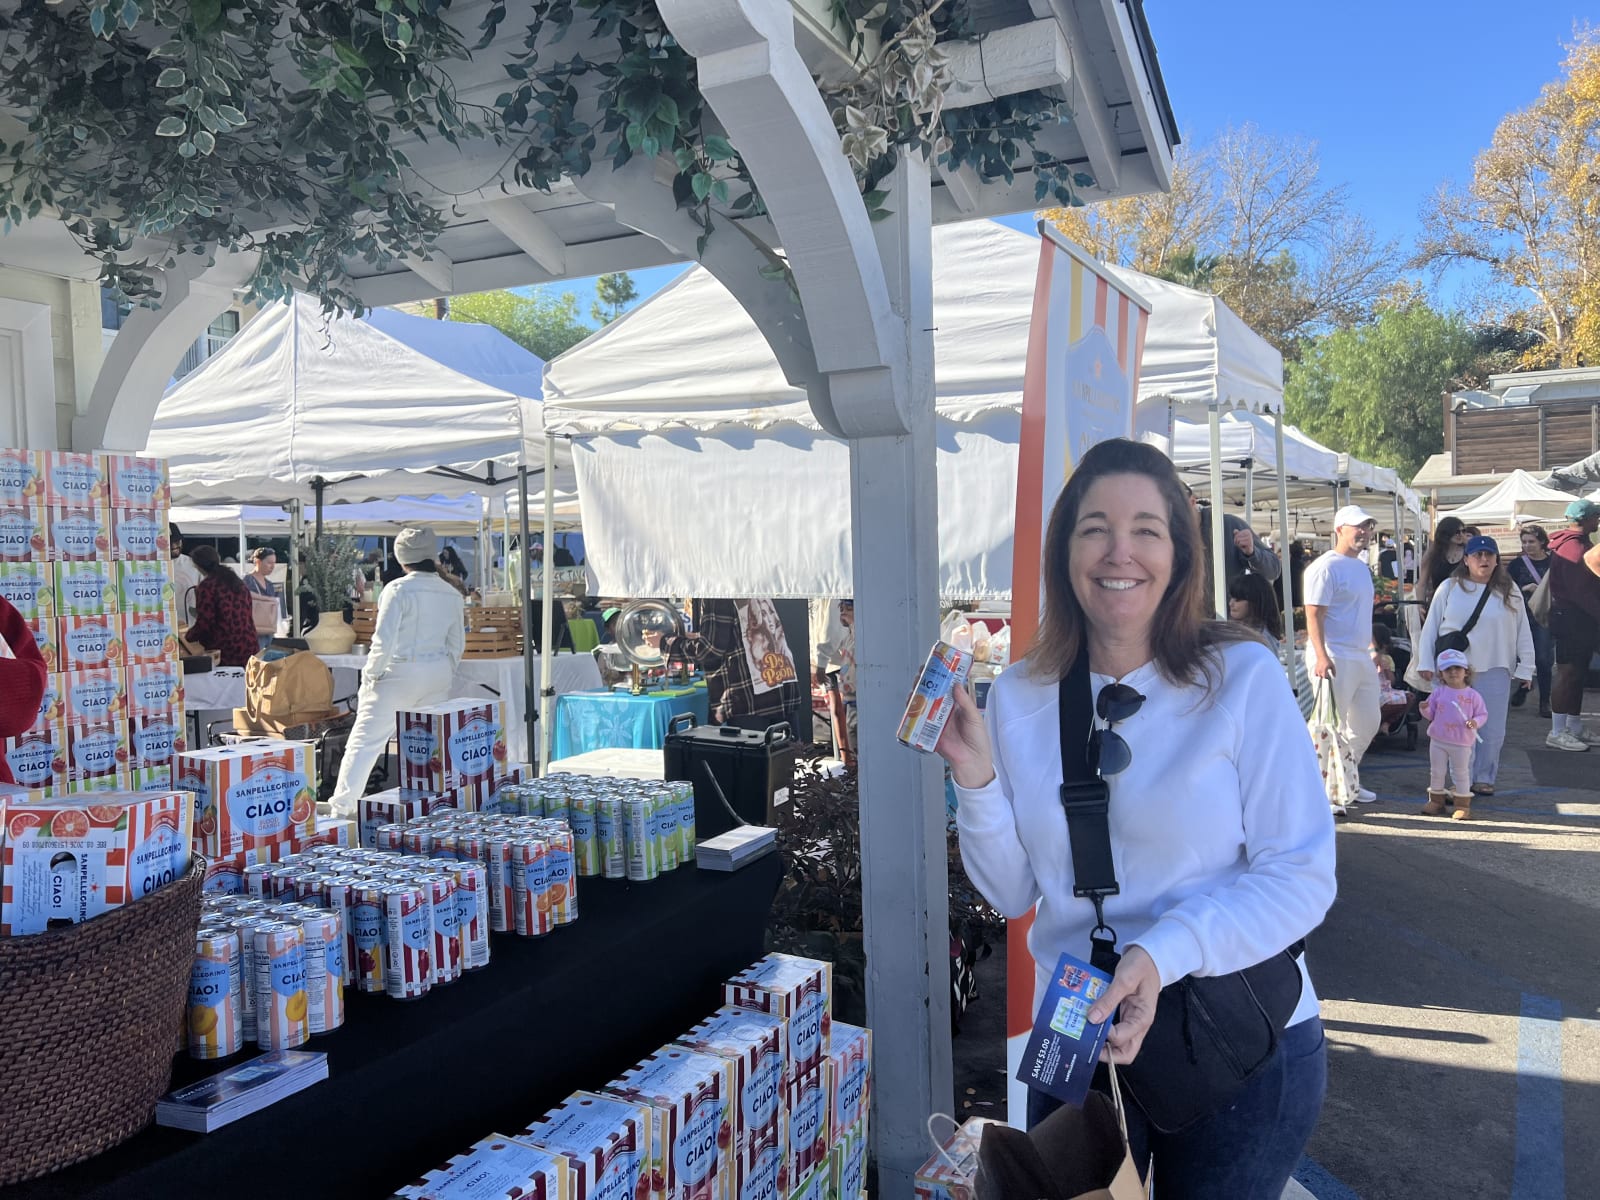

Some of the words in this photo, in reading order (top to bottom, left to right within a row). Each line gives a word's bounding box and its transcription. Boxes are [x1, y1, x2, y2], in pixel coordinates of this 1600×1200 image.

[62, 481, 92, 490] CIAO!
[128, 484, 154, 492] CIAO!
[64, 536, 94, 544] CIAO!
[128, 536, 155, 544] CIAO!
[5, 592, 35, 600] CIAO!
[73, 590, 102, 598] CIAO!
[135, 587, 160, 596] CIAO!
[78, 643, 106, 652] CIAO!
[136, 638, 163, 648] CIAO!
[82, 697, 111, 707] CIAO!
[144, 690, 170, 700] CIAO!
[455, 730, 496, 744] SANPELLEGRINO
[146, 740, 172, 750] CIAO!
[408, 746, 430, 755] CIAO!
[86, 751, 113, 761] CIAO!
[462, 745, 491, 762] CIAO!
[18, 761, 50, 772] CIAO!
[236, 780, 300, 798] SANPELLEGRINO
[246, 799, 290, 818] CIAO!
[136, 842, 182, 864] SANPELLEGRINO
[53, 876, 62, 908] CIAO!
[792, 1000, 824, 1028] SANPELLEGRINO
[797, 1018, 820, 1046] CIAO!
[1032, 1058, 1044, 1078] SAVE
[1038, 1038, 1050, 1058] $3.00
[748, 1060, 783, 1093] SANPELLEGRINO
[752, 1082, 776, 1112] CIAO!
[844, 1084, 862, 1110] CIAO!
[570, 1122, 587, 1135] CIAO!
[680, 1108, 723, 1146] SANPELLEGRINO
[798, 1112, 818, 1138] CIAO!
[686, 1130, 716, 1166] CIAO!
[436, 1160, 481, 1191] SANPELLEGRINO
[466, 1172, 490, 1188] CIAO!
[746, 1154, 782, 1192] SANPELLEGRINO
